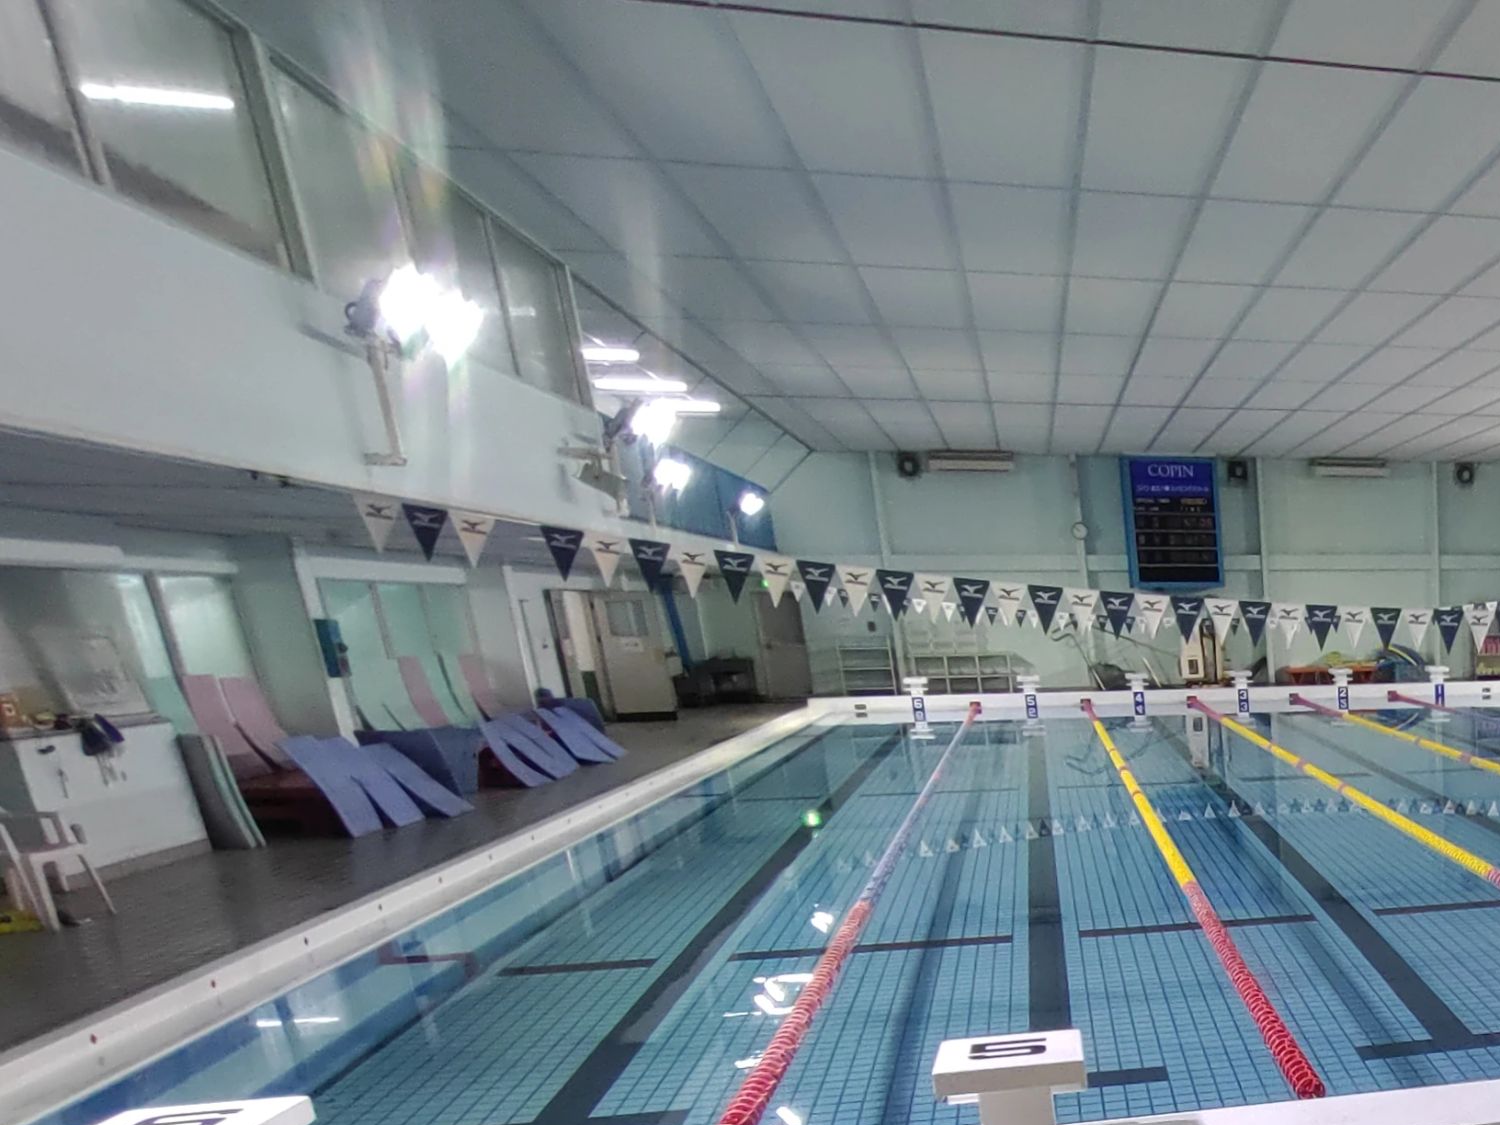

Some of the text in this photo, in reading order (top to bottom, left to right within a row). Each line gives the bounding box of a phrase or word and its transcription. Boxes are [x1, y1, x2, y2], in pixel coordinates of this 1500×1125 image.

[1147, 464, 1194, 478] COPIN
[1239, 691, 1246, 699] 3
[1340, 688, 1347, 697] 2
[1027, 696, 1035, 706] 5
[1136, 694, 1142, 703] 4
[914, 699, 922, 709] 6
[967, 1037, 1047, 1060] 5
